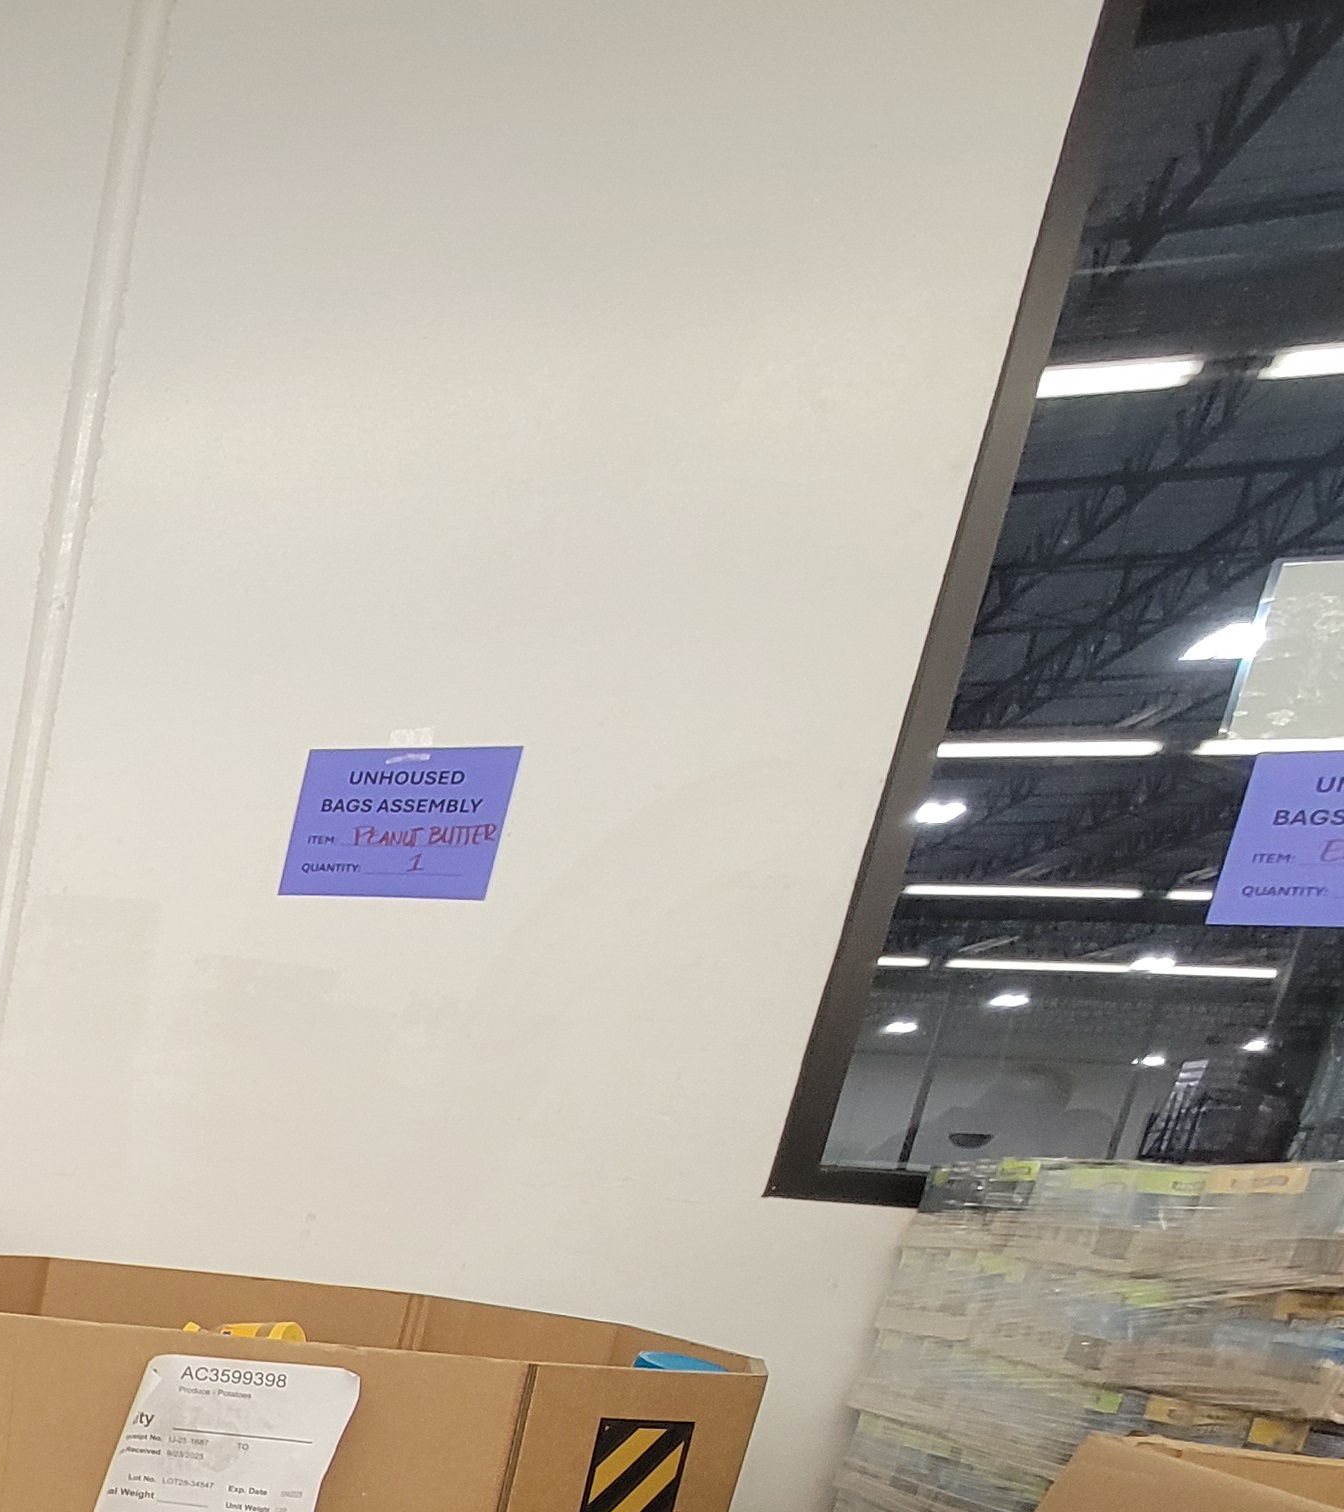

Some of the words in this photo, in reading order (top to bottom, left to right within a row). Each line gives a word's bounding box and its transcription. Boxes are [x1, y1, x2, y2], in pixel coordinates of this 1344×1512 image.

[349, 770, 466, 786] UNHOUSED
[320, 798, 373, 813] BAGS
[376, 798, 483, 813] ASSEMBLY
[353, 825, 424, 847] PEANUT
[428, 823, 498, 846] BUTTER
[406, 853, 424, 873] 1
[1252, 853, 1296, 864] ITEM:
[1241, 886, 1329, 897] QUANTITY:
[180, 1365, 288, 1388] AC3599398
[178, 1385, 211, 1397] Produce
[217, 1388, 252, 1400] Potatoes
[237, 1442, 249, 1451] TO
[128, 1473, 141, 1482] Lot
[120, 1487, 155, 1499] Weight
[228, 1485, 246, 1495] Exp.
[248, 1487, 268, 1496] Date
[225, 1502, 243, 1511] Unit
